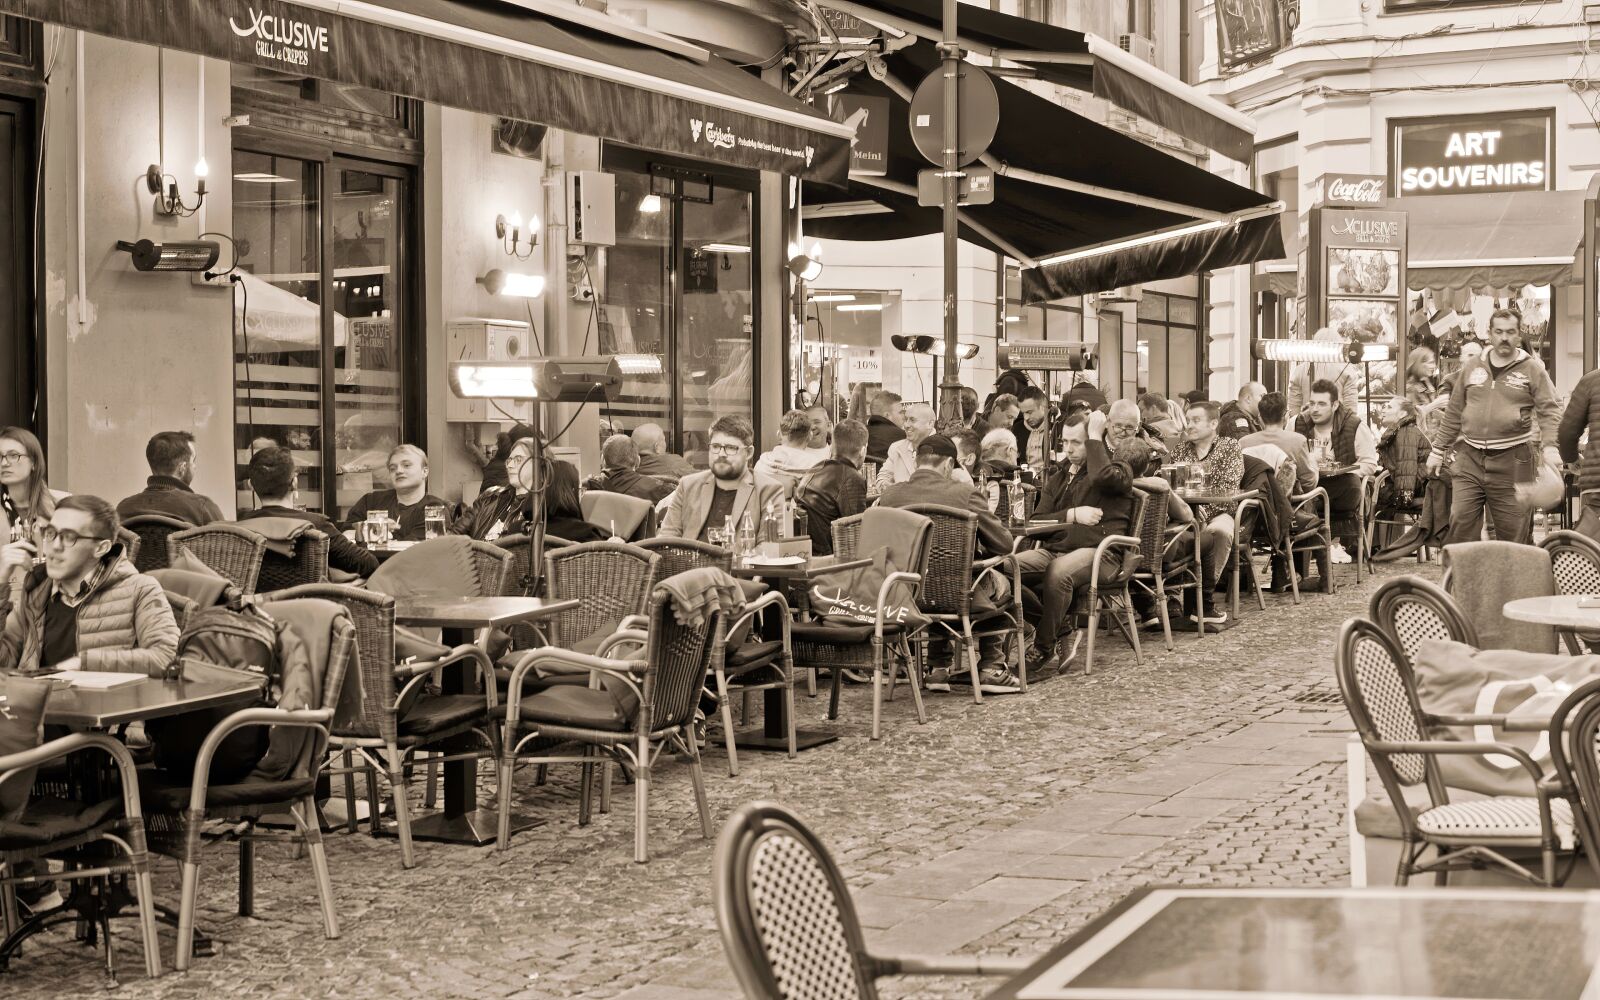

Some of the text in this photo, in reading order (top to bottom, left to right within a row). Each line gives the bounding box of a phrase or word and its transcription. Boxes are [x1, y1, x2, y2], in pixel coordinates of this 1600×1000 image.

[229, 7, 329, 52] XCLUSIVE
[256, 40, 275, 59] GRILL
[276, 50, 282, 60] &
[706, 121, 735, 148] Carlsberg
[1445, 130, 1502, 157] ART
[854, 150, 881, 160] Meinl
[1402, 161, 1544, 190] SOUVENIRS
[1331, 217, 1397, 236] XCLUSIVE
[853, 361, 878, 370] -10%
